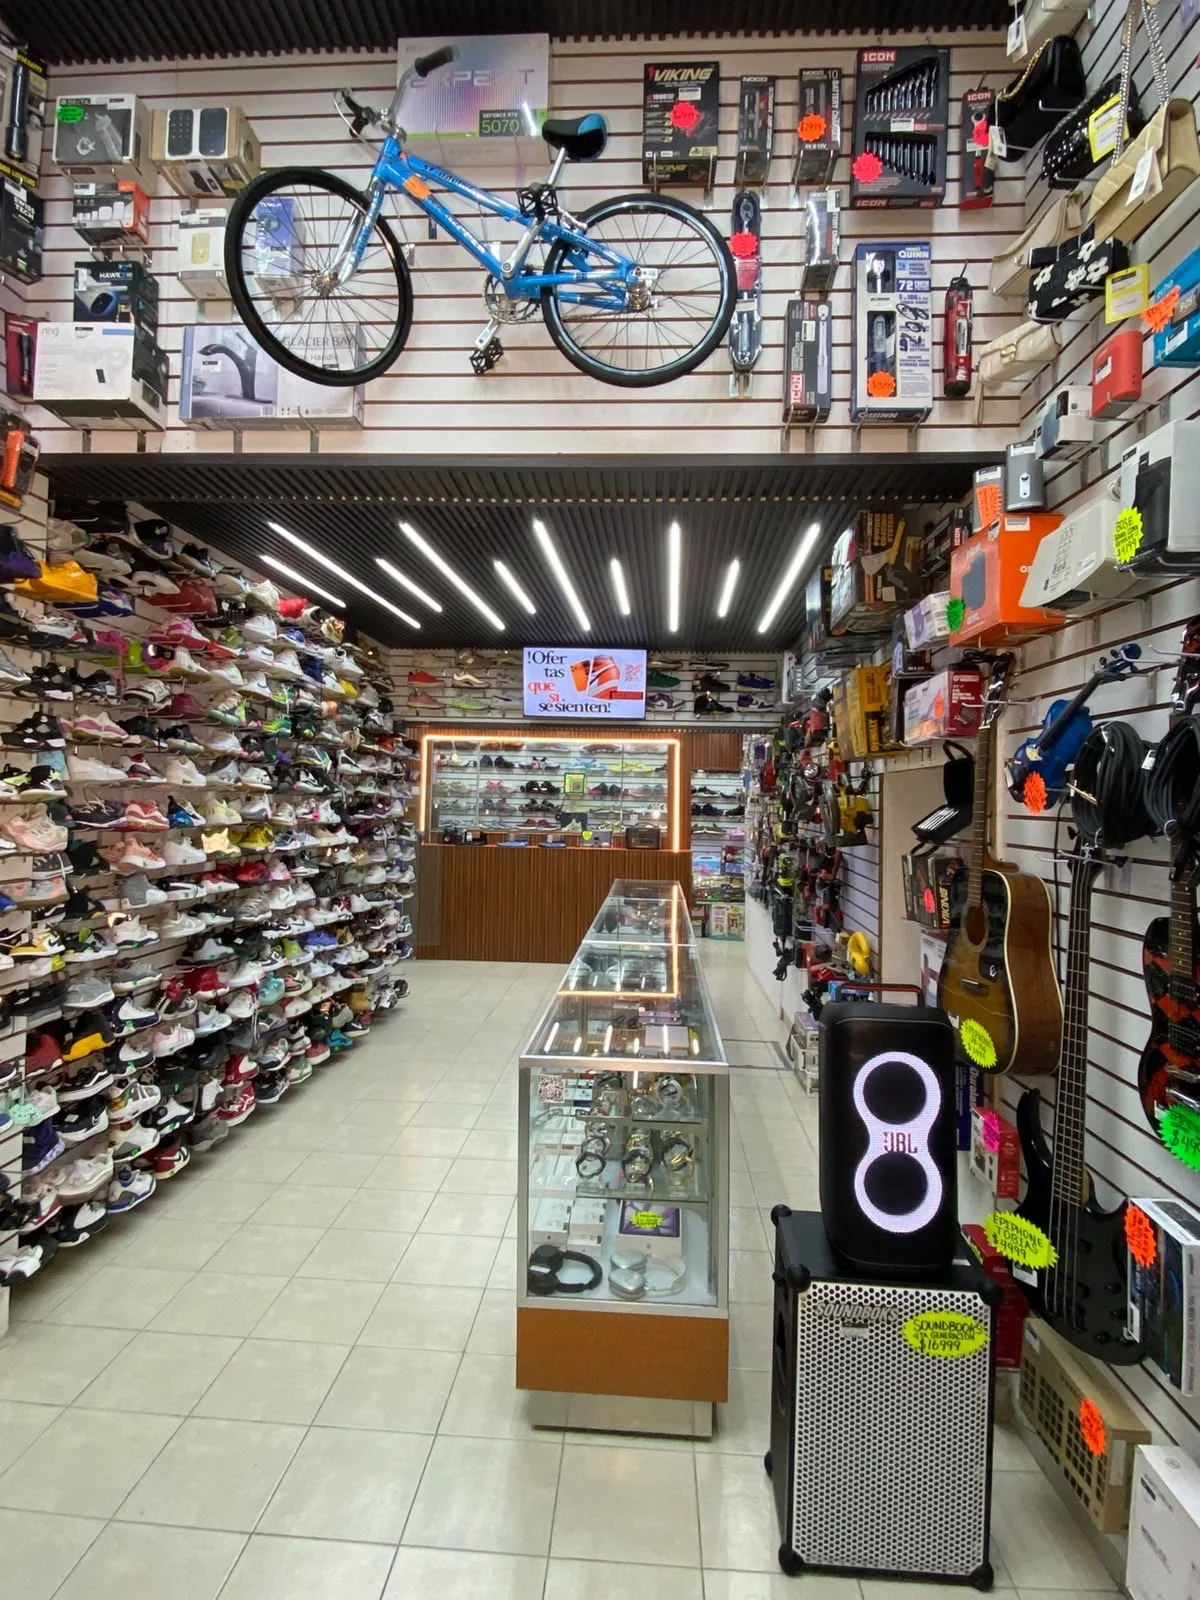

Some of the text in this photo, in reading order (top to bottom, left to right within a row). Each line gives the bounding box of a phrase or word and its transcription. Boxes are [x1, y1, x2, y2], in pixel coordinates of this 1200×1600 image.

[863, 52, 895, 62] ICON
[654, 68, 714, 81] VIKING
[967, 92, 991, 101] ICON
[482, 119, 519, 133] 5070
[856, 199, 887, 207] ICON
[898, 250, 929, 258] QUINN
[898, 280, 914, 290] 72
[41, 328, 59, 337] ring
[282, 336, 357, 347] GLACIER BAY
[791, 375, 800, 404] ICON
[857, 411, 899, 419] QUINN
[1115, 516, 1133, 531] BOSE
[527, 650, 568, 664] !Ofer
[544, 667, 565, 678] tas
[528, 681, 555, 694] que
[538, 703, 611, 713] se sienten!
[939, 887, 951, 924] VIKING
[969, 1066, 979, 1108] Duralas
[883, 1132, 918, 1154] JBL
[993, 1213, 1044, 1248] EPIPHONE
[995, 1226, 1038, 1254] TOBIAS
[814, 1302, 899, 1322] SOUNDBOKS
[913, 1319, 984, 1335] SOUNDBOOKS
[930, 1332, 975, 1341] GENERACION
[919, 1339, 961, 1353] $16999
